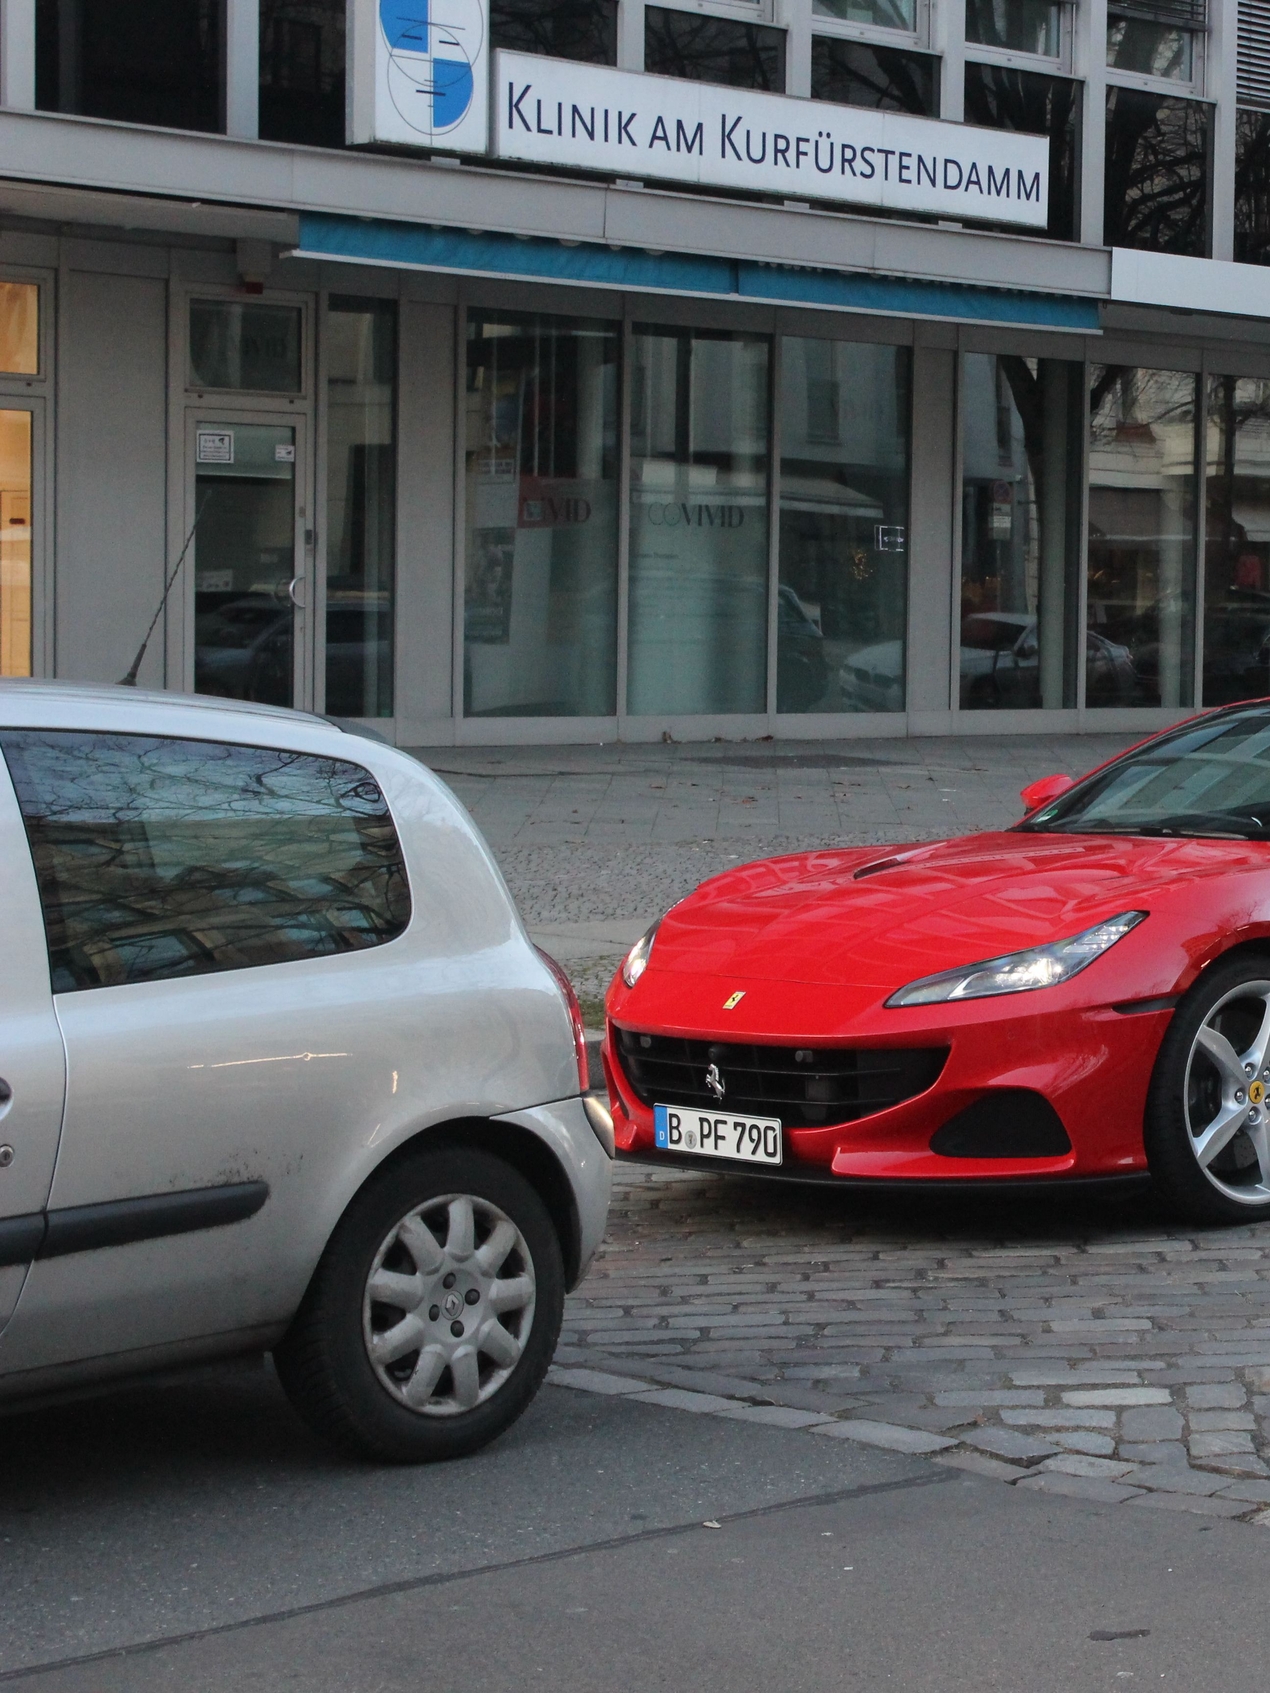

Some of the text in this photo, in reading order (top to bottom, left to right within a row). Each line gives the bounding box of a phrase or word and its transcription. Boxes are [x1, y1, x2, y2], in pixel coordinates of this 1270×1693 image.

[508, 81, 1040, 202] KLINIK AM KURFÜRSTENDAMM
[648, 501, 745, 528] COVIVID
[668, 1112, 778, 1158] B PF 790
